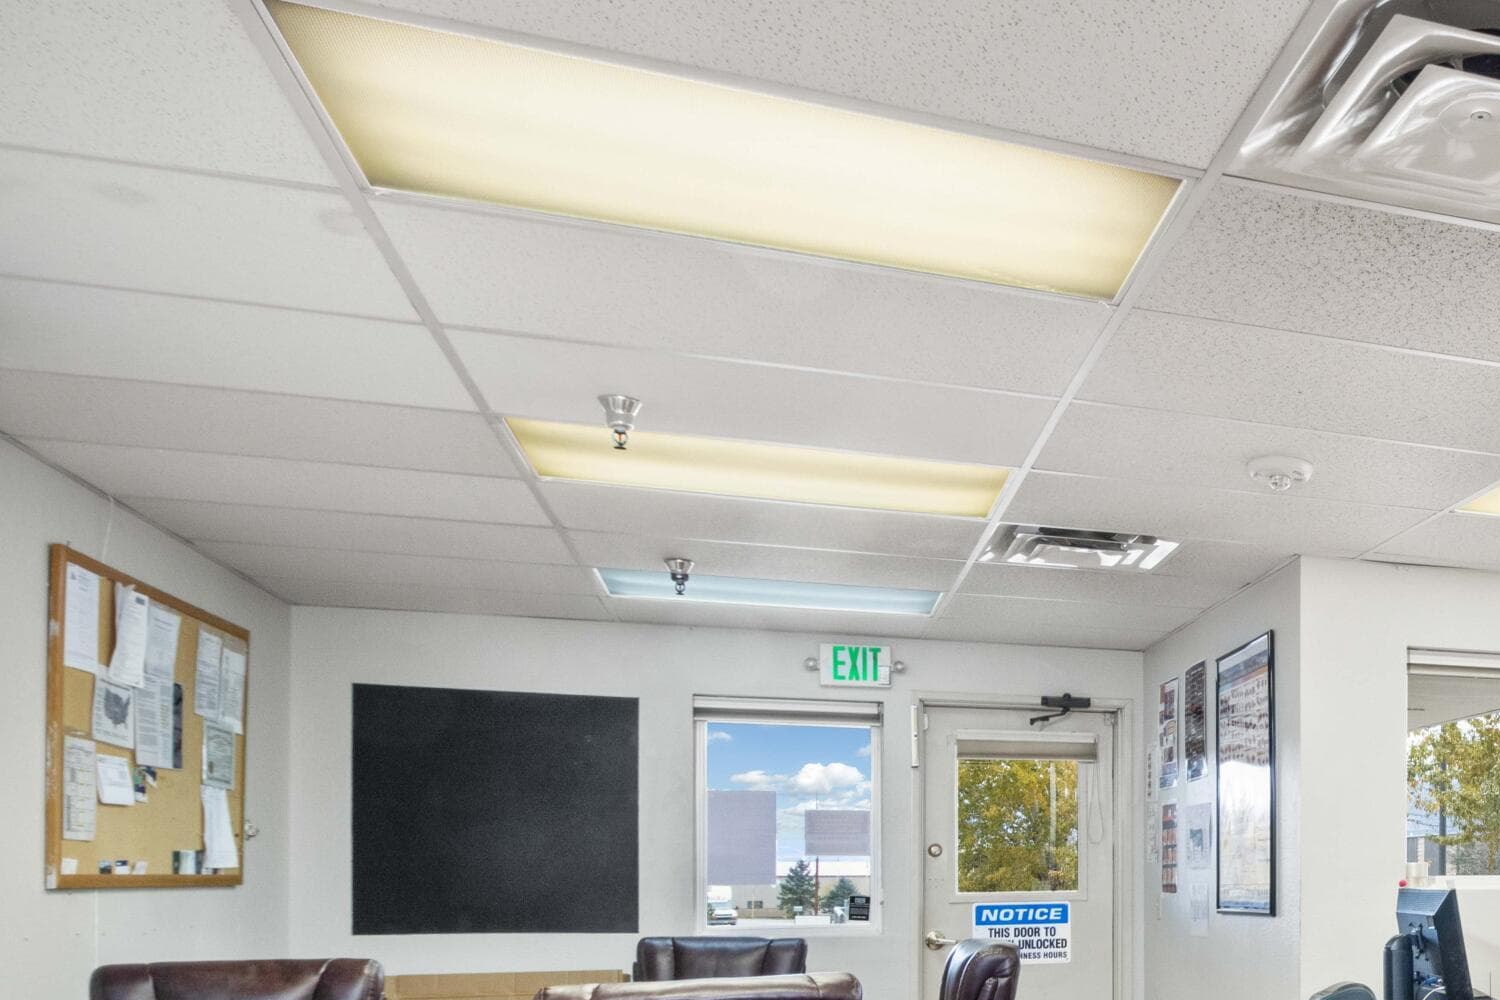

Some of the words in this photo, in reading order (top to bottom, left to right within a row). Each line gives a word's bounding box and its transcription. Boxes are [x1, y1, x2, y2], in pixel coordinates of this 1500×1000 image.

[833, 645, 881, 681] EXIT
[981, 907, 1063, 922] NOTICE
[988, 927, 1010, 938] THIS
[1014, 926, 1041, 938] DOOR
[1044, 926, 1056, 937] TO
[1018, 938, 1068, 949] UNLOCKED
[1043, 951, 1068, 959] HOURS
